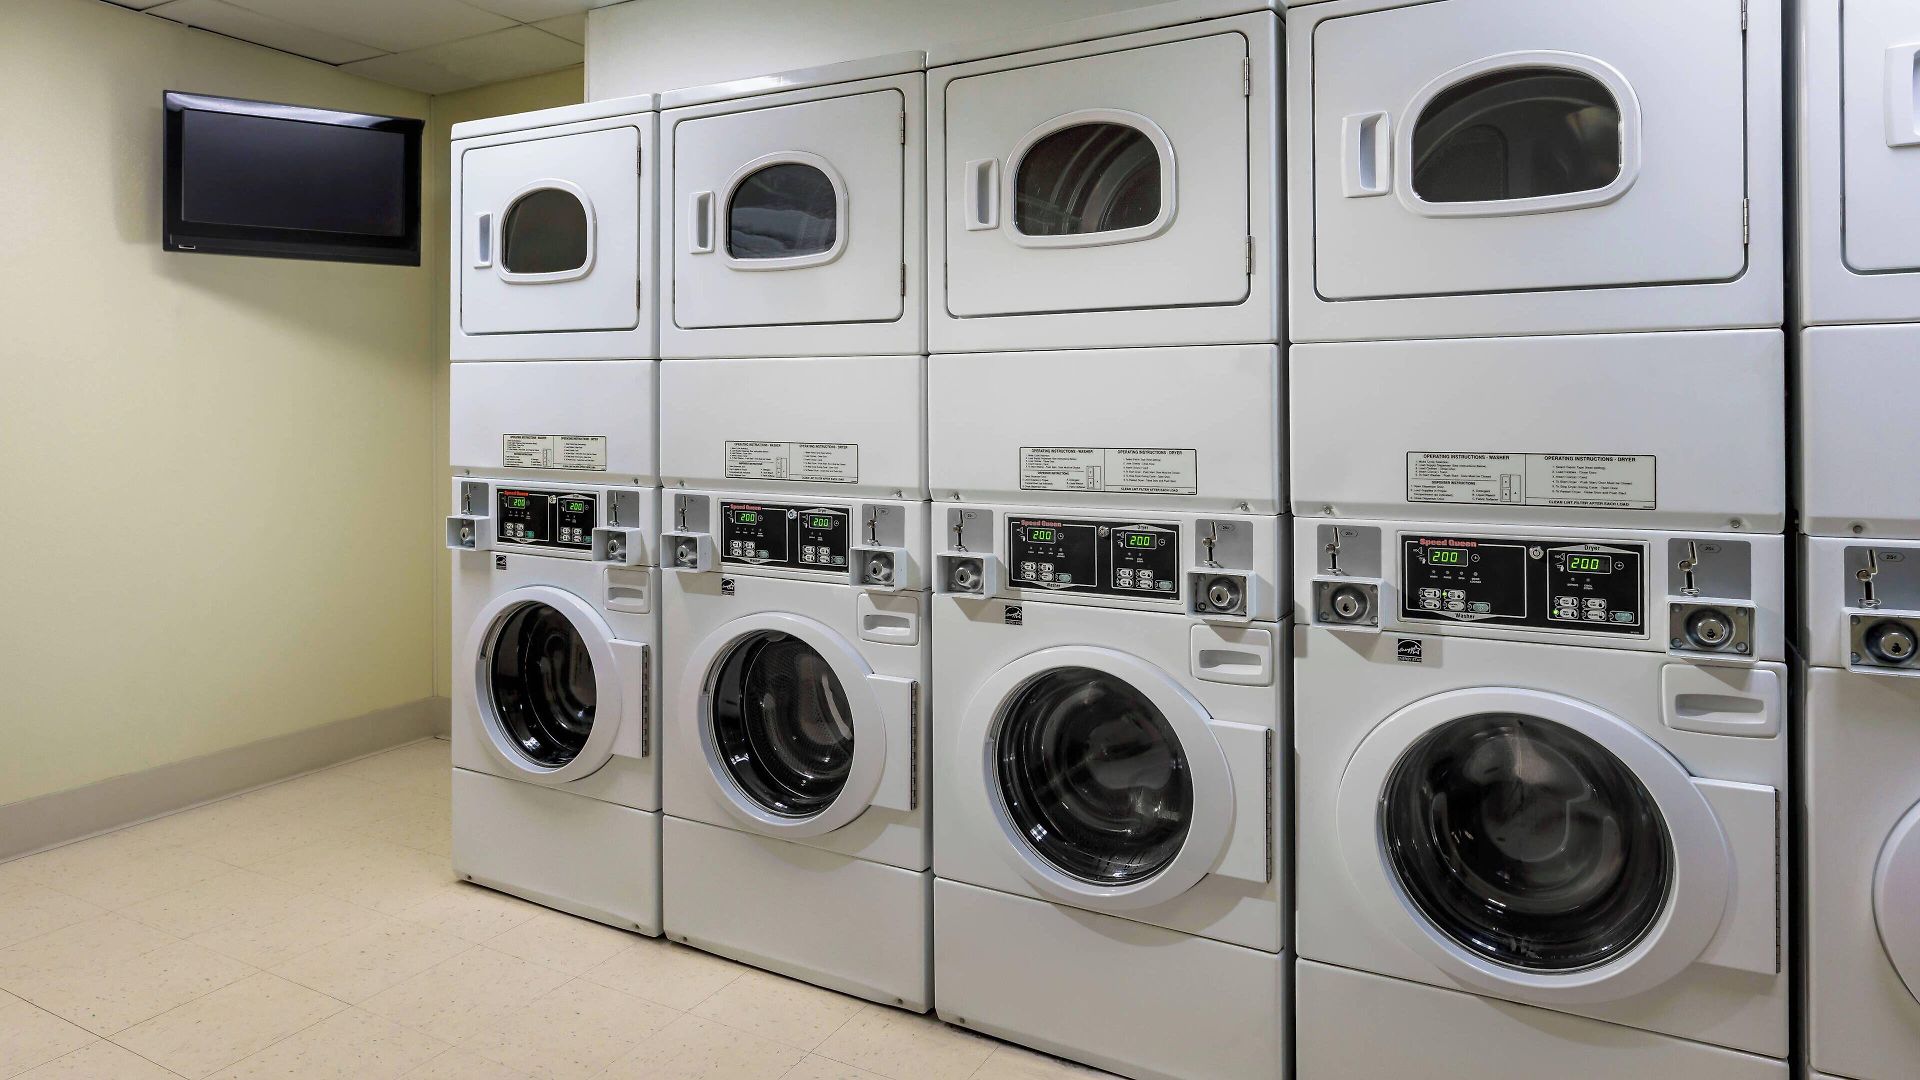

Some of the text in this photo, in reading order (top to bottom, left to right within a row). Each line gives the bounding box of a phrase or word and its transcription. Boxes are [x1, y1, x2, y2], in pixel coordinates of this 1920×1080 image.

[513, 499, 525, 507] 200
[569, 502, 583, 511] 200
[740, 513, 755, 522] 200
[813, 518, 829, 527] 200
[1032, 530, 1052, 540] 200
[1129, 536, 1150, 546] 200
[1420, 538, 1477, 548] Speed Queen
[1432, 551, 1458, 563] 200
[1571, 558, 1600, 570] 200
